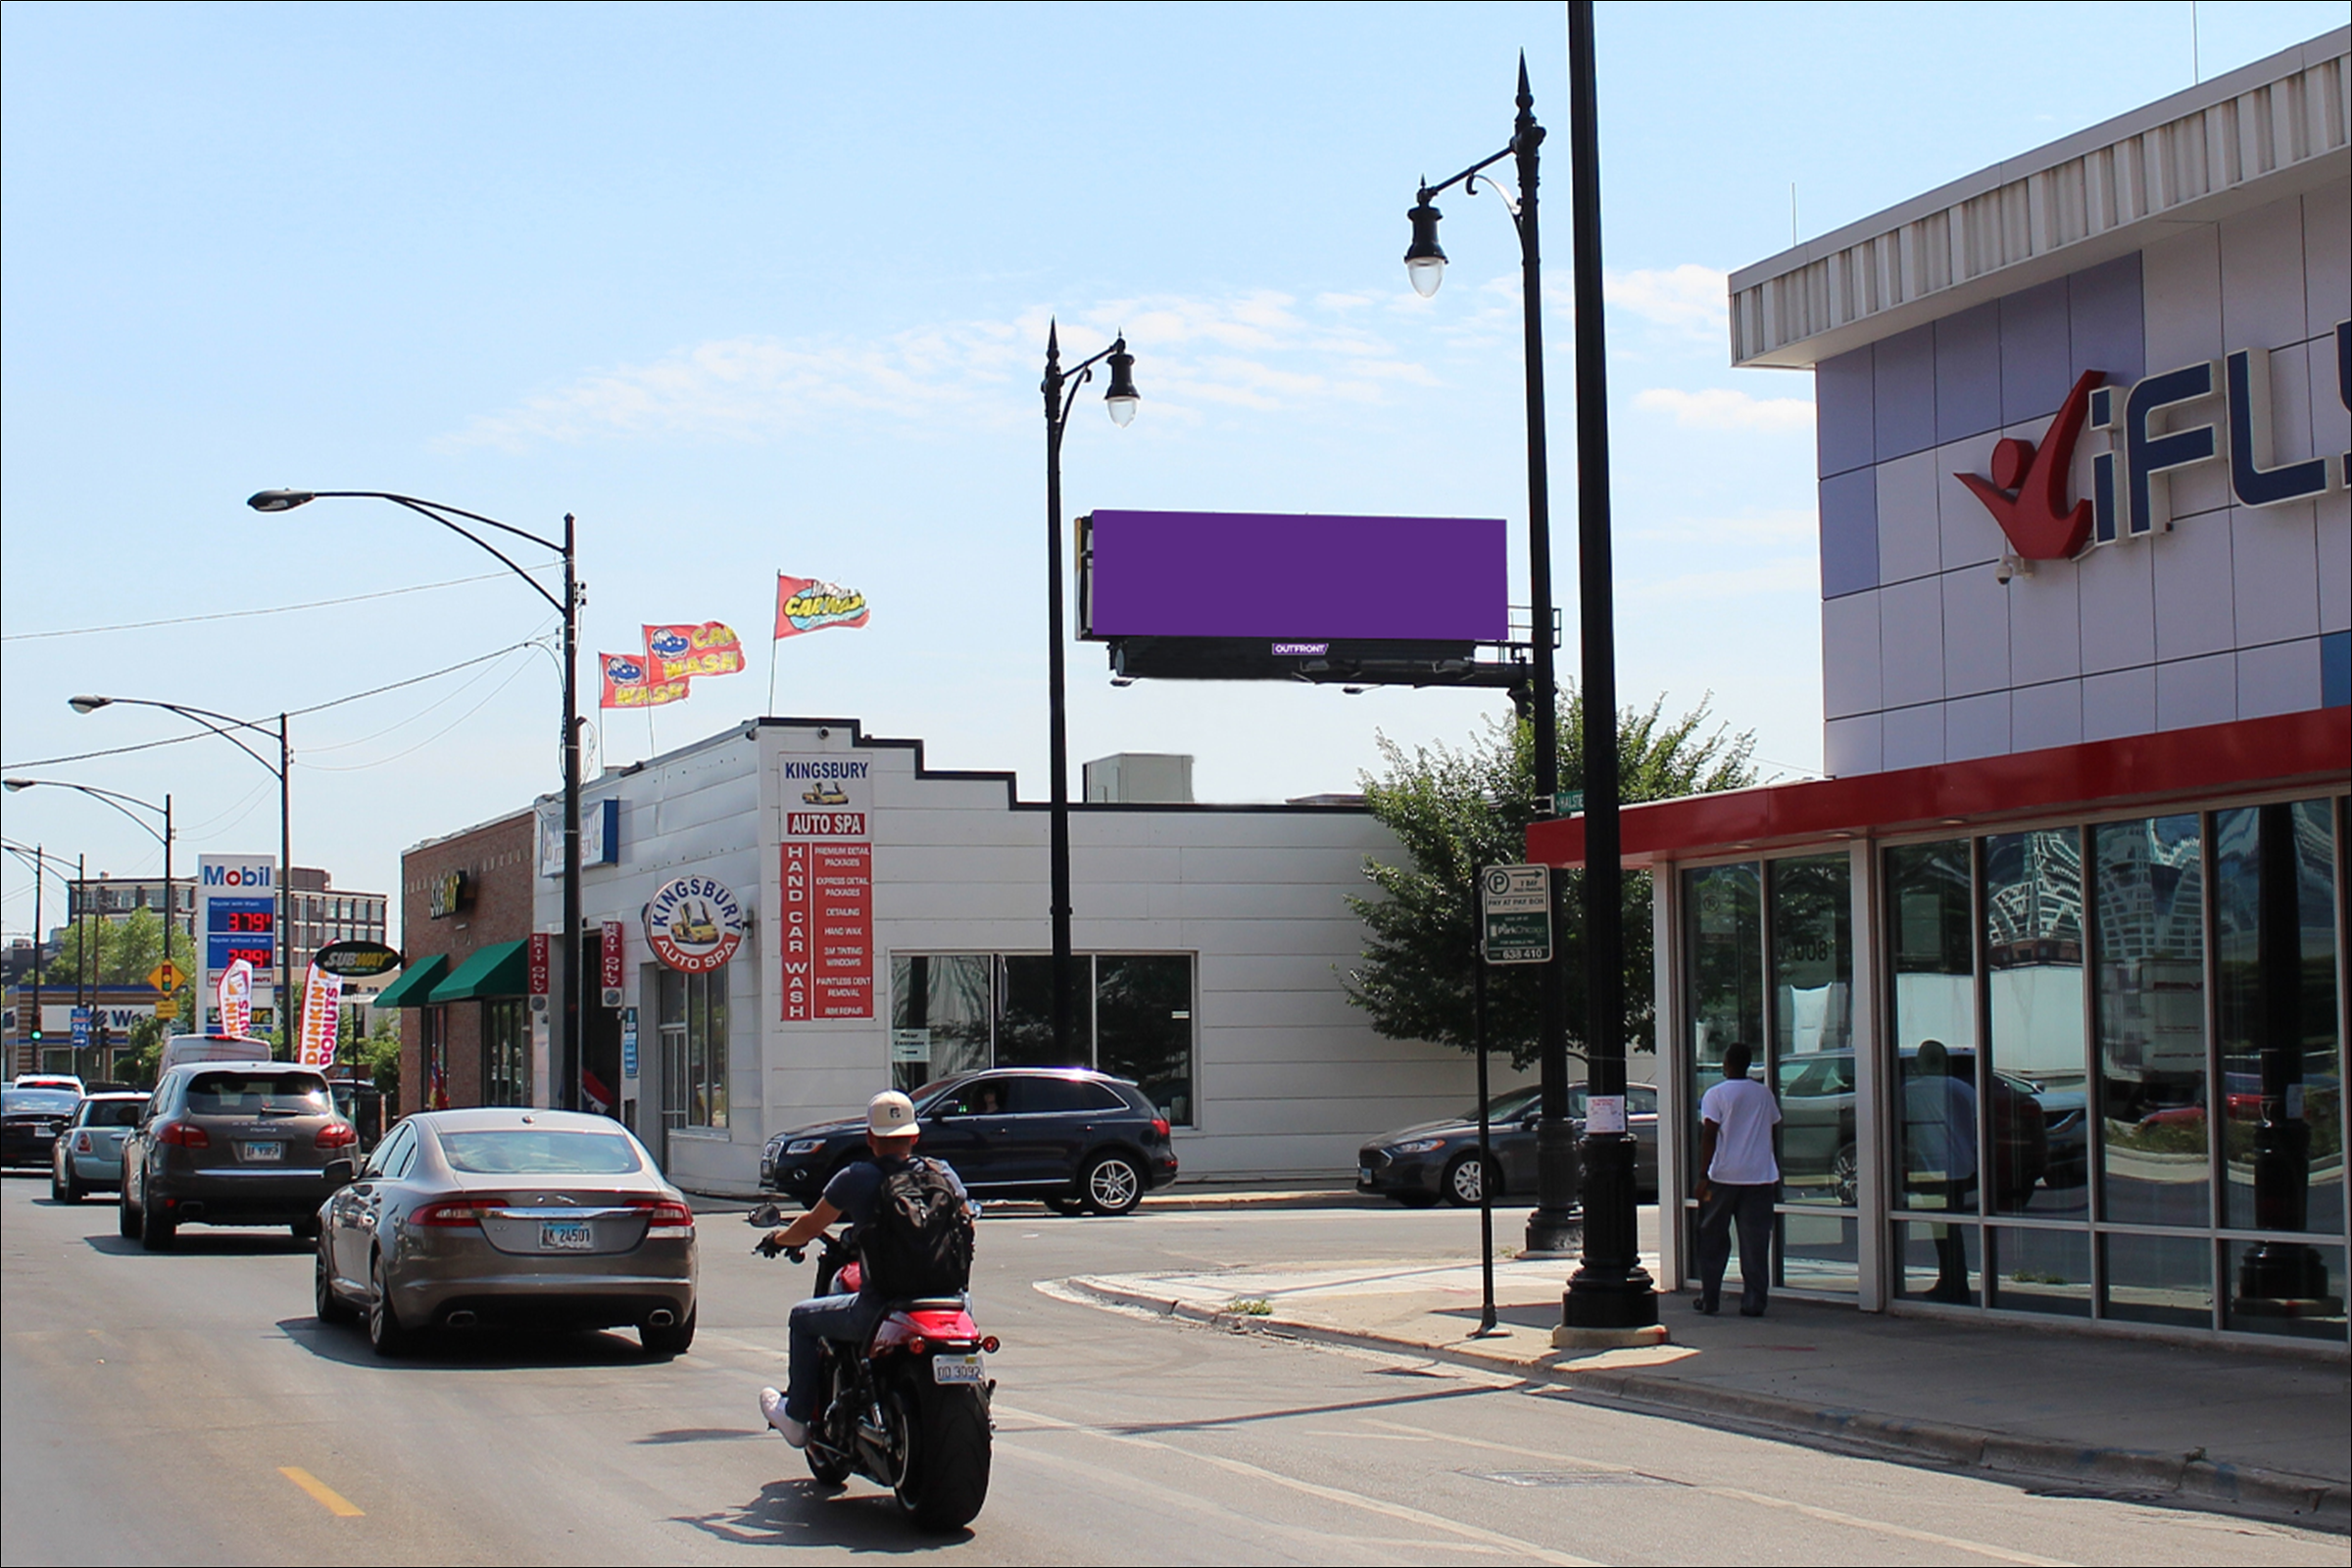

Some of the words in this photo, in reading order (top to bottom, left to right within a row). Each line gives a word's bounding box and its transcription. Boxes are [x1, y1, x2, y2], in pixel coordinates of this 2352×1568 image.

[2088, 319, 2351, 546] iFL
[1275, 644, 1325, 653] OUTFRONT
[663, 652, 738, 680] WASH
[615, 683, 685, 705] WASH
[786, 762, 868, 779] KINGSBURY
[1560, 793, 1584, 809] HALSTE
[792, 814, 831, 834] AUTO
[835, 814, 861, 834] SPA
[204, 865, 270, 887] Mobil
[788, 847, 804, 902] HAND
[653, 878, 741, 930] KINGSBURY
[826, 907, 860, 916] DETAILING
[604, 922, 619, 952] EXIT
[789, 911, 804, 952] CAR
[324, 953, 388, 966] SUBWAY
[533, 935, 546, 961] EXIT
[658, 941, 700, 969] AUTO
[705, 942, 736, 967] SPA
[1523, 949, 1543, 958] 410
[532, 965, 546, 993] ONLY
[606, 956, 619, 986] ONLY
[785, 962, 808, 1017] WASH
[73, 1024, 87, 1033] 94
[305, 980, 324, 1065] DUNKIN'
[319, 987, 339, 1065] DONUTS
